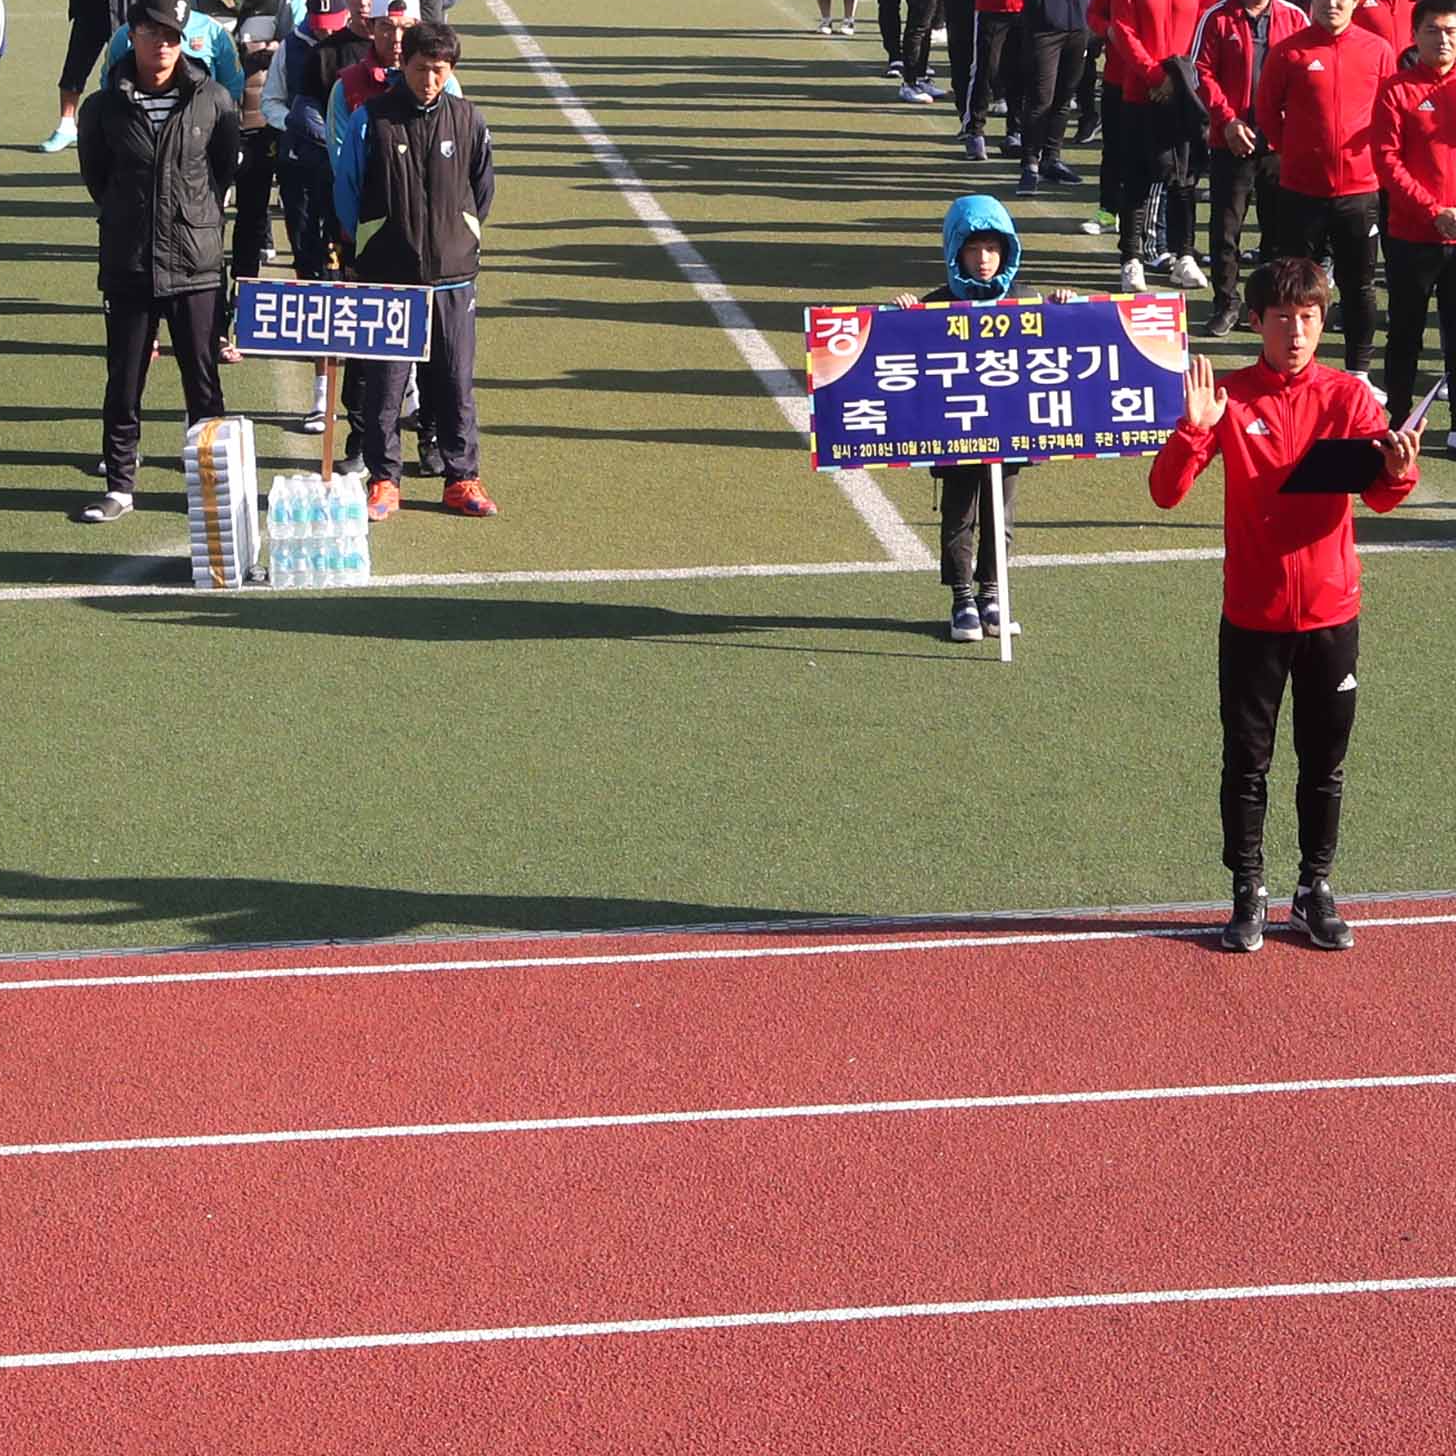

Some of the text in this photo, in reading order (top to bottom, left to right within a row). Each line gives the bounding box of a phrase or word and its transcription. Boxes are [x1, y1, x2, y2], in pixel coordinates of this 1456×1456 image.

[252, 293, 412, 349] 로타리축구회
[815, 317, 861, 356] 경
[946, 312, 1044, 340] 제 29 회
[1130, 305, 1176, 342] 축
[873, 345, 1120, 392] 동구청장기
[859, 442, 894, 457] 2018년
[896, 440, 918, 455] 10월
[947, 436, 1000, 454] 28일(2일간)
